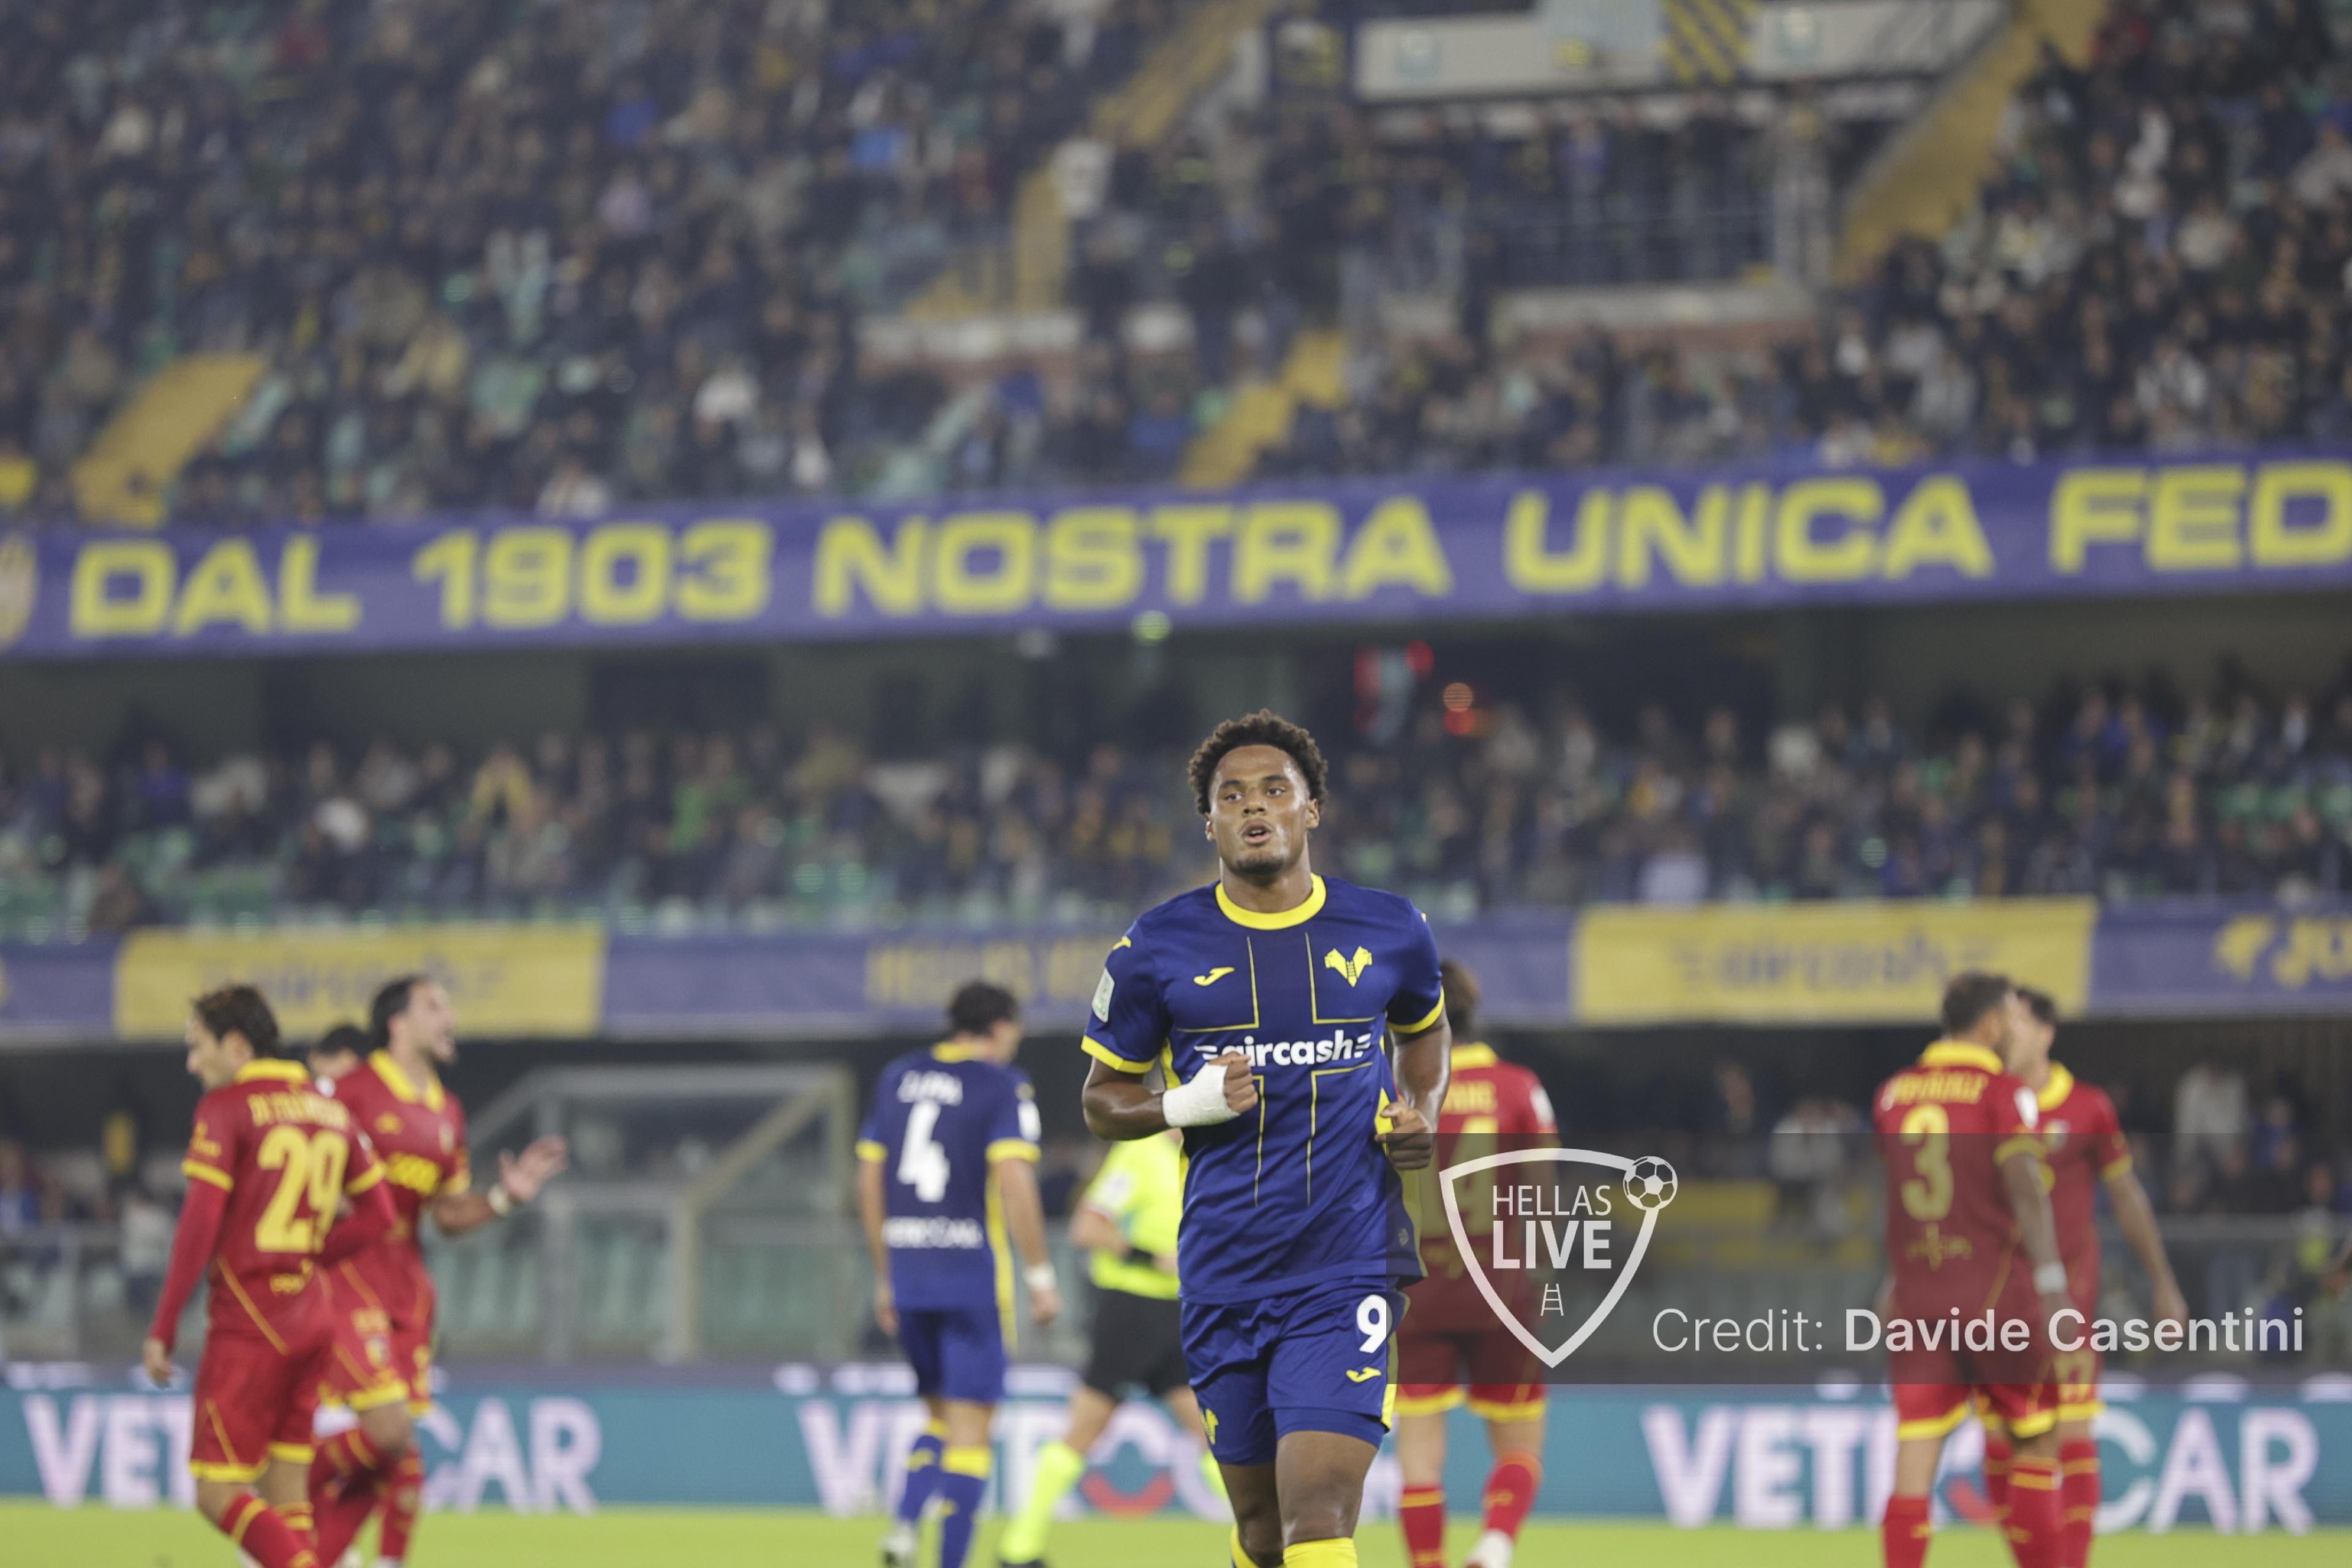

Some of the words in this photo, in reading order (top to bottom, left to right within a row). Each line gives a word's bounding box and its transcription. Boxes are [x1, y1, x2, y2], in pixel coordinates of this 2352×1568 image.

[71, 532, 361, 639] DAL
[413, 518, 774, 630] 1903
[814, 495, 1453, 616] NOSTRA
[1504, 473, 1996, 594] UNICA
[255, 1125, 350, 1253] 29
[897, 1099, 951, 1202] 4
[1900, 1104, 1954, 1221] 3
[1356, 1293, 1393, 1354] 9
